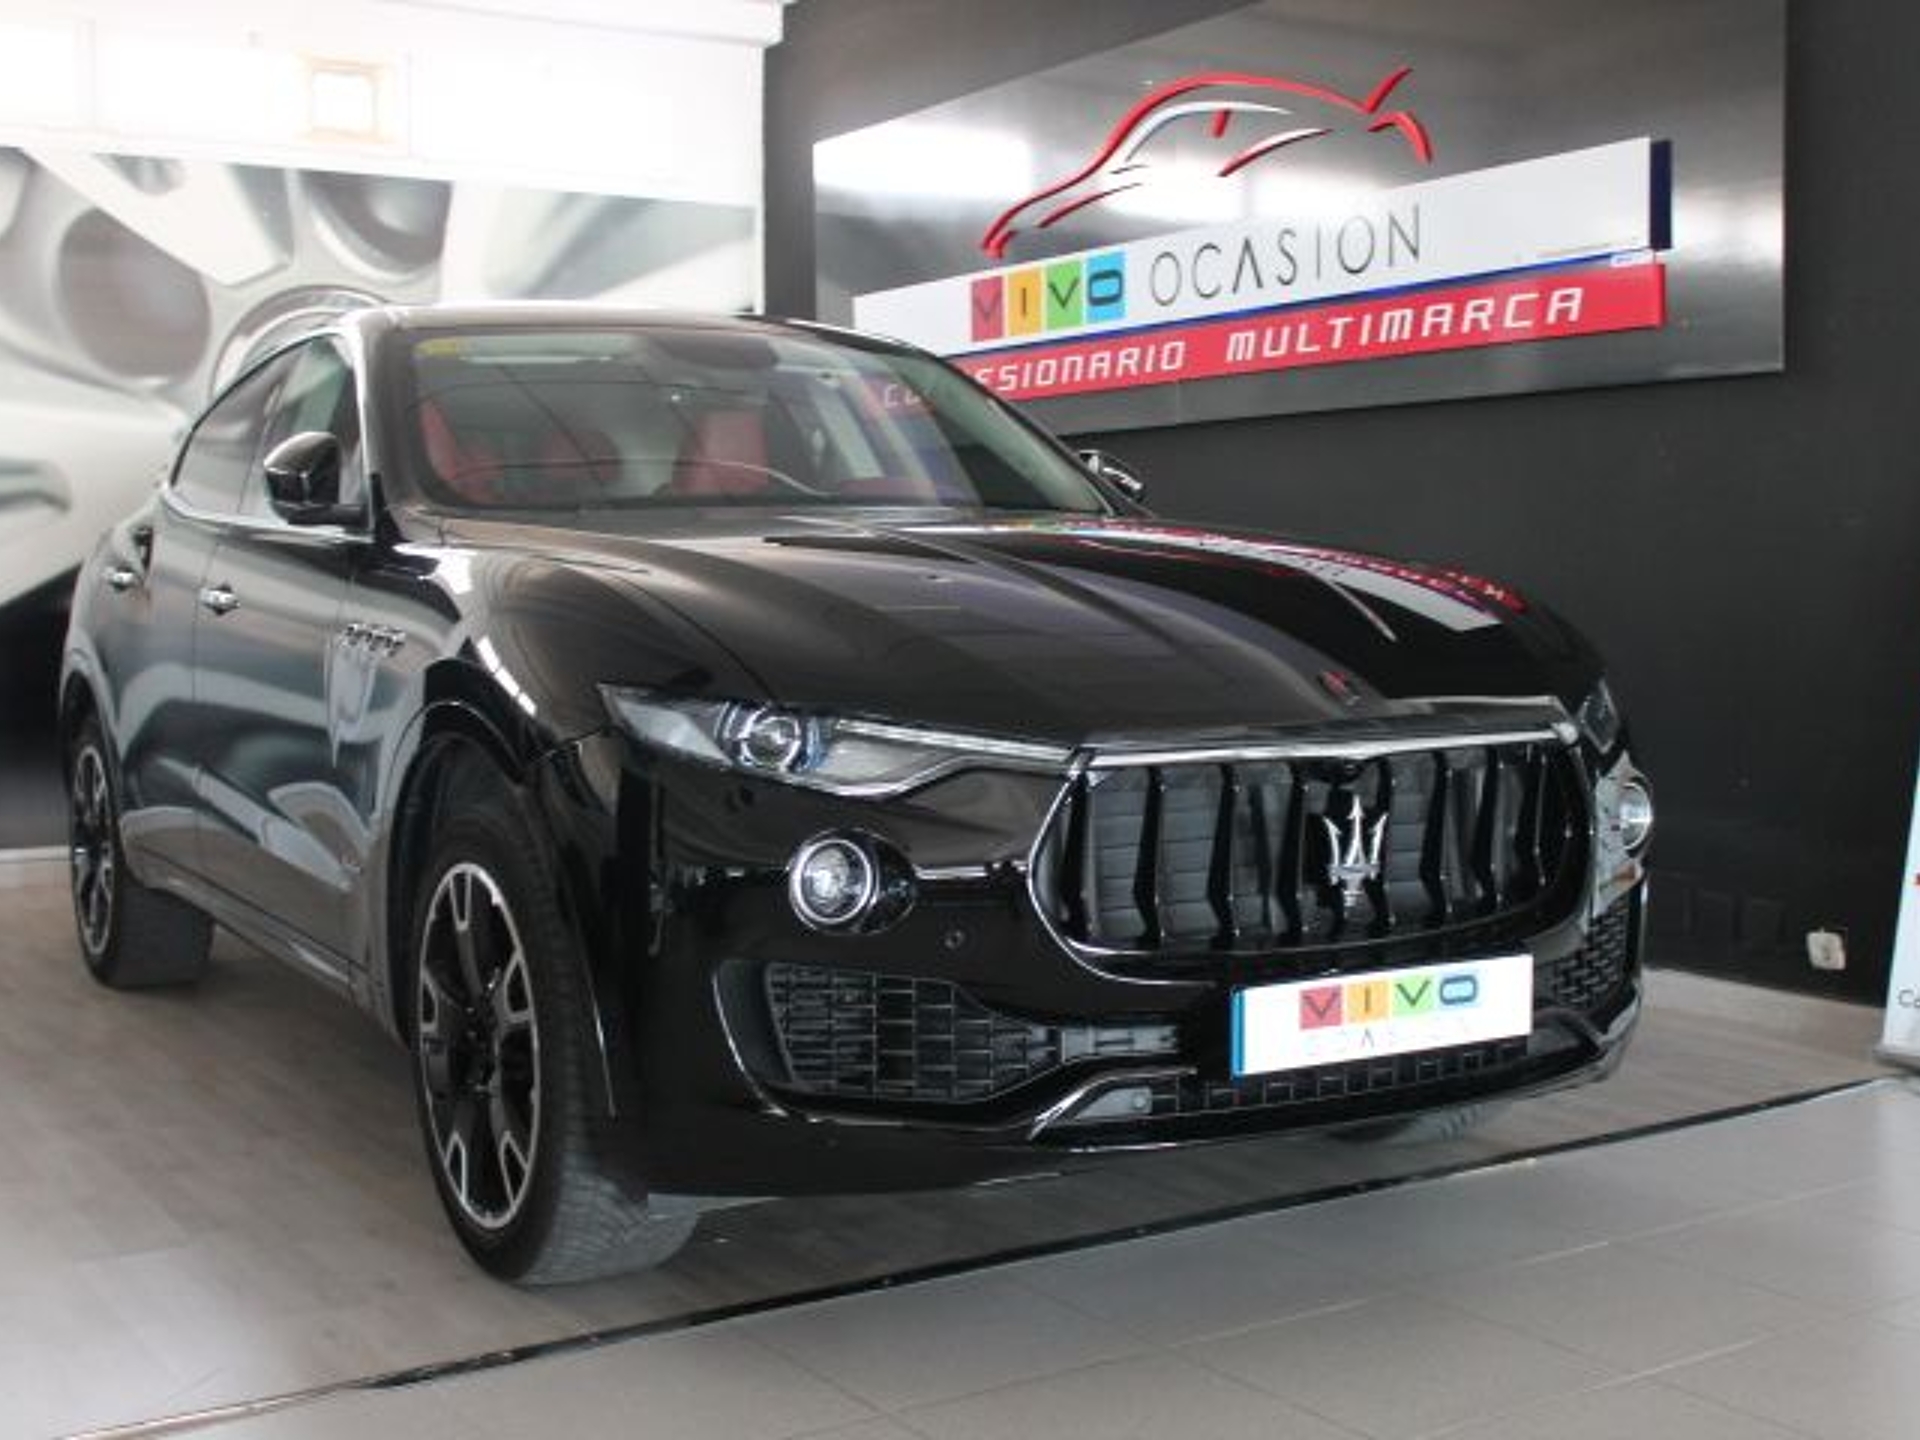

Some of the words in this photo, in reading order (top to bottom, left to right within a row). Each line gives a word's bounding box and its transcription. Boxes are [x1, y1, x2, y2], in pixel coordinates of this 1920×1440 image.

[972, 269, 1123, 321] VIVO
[1150, 204, 1420, 306] OCASION
[1226, 287, 1584, 361] MULTIMARCA
[1302, 974, 1476, 1018] VIVO
